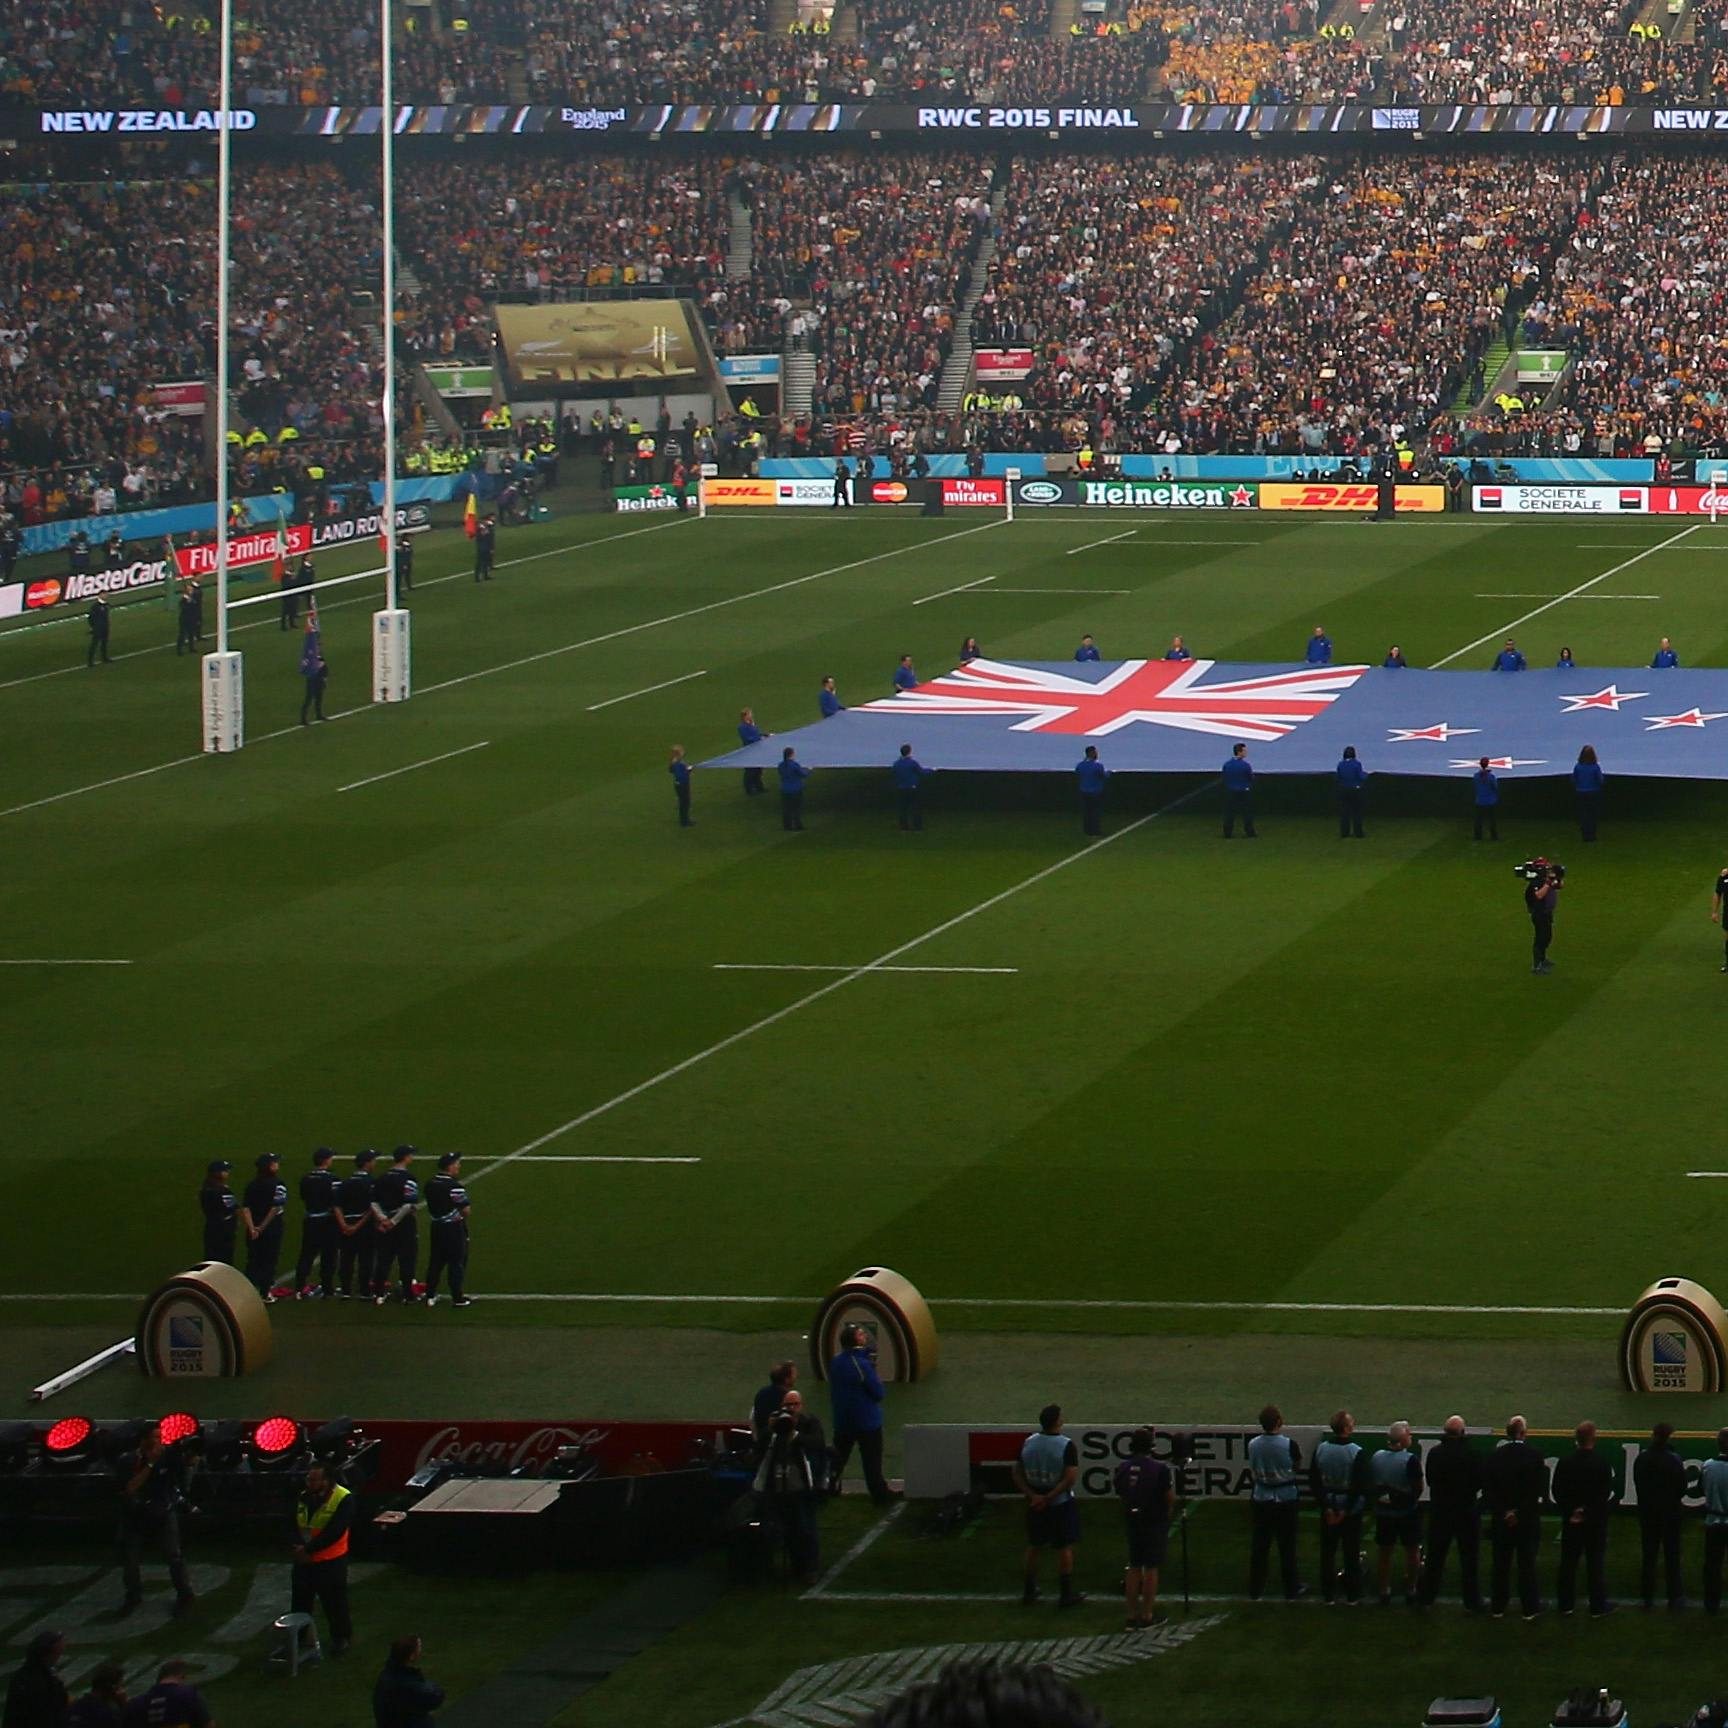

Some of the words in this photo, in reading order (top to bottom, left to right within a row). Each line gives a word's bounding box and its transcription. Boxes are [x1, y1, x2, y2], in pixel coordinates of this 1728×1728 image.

[41, 111, 114, 132] NEW
[561, 108, 625, 123] England
[918, 108, 982, 127] RWC
[988, 108, 1050, 127] 2015
[1058, 108, 1139, 127] FINAL
[1653, 110, 1711, 129] NEW
[1391, 120, 1420, 129] 2015
[521, 361, 697, 381] FINAL
[717, 486, 761, 497] DHL
[956, 480, 975, 491] Fly
[943, 490, 998, 503] mirates
[1085, 481, 1226, 507] Heineken
[1519, 488, 1587, 499] SOCIETE
[616, 494, 697, 512] Heinekn
[1519, 500, 1603, 510] GENERALE
[312, 520, 355, 544] LAND
[1653, 1365, 1686, 1373] RUGBY
[1653, 1379, 1686, 1388] 2015
